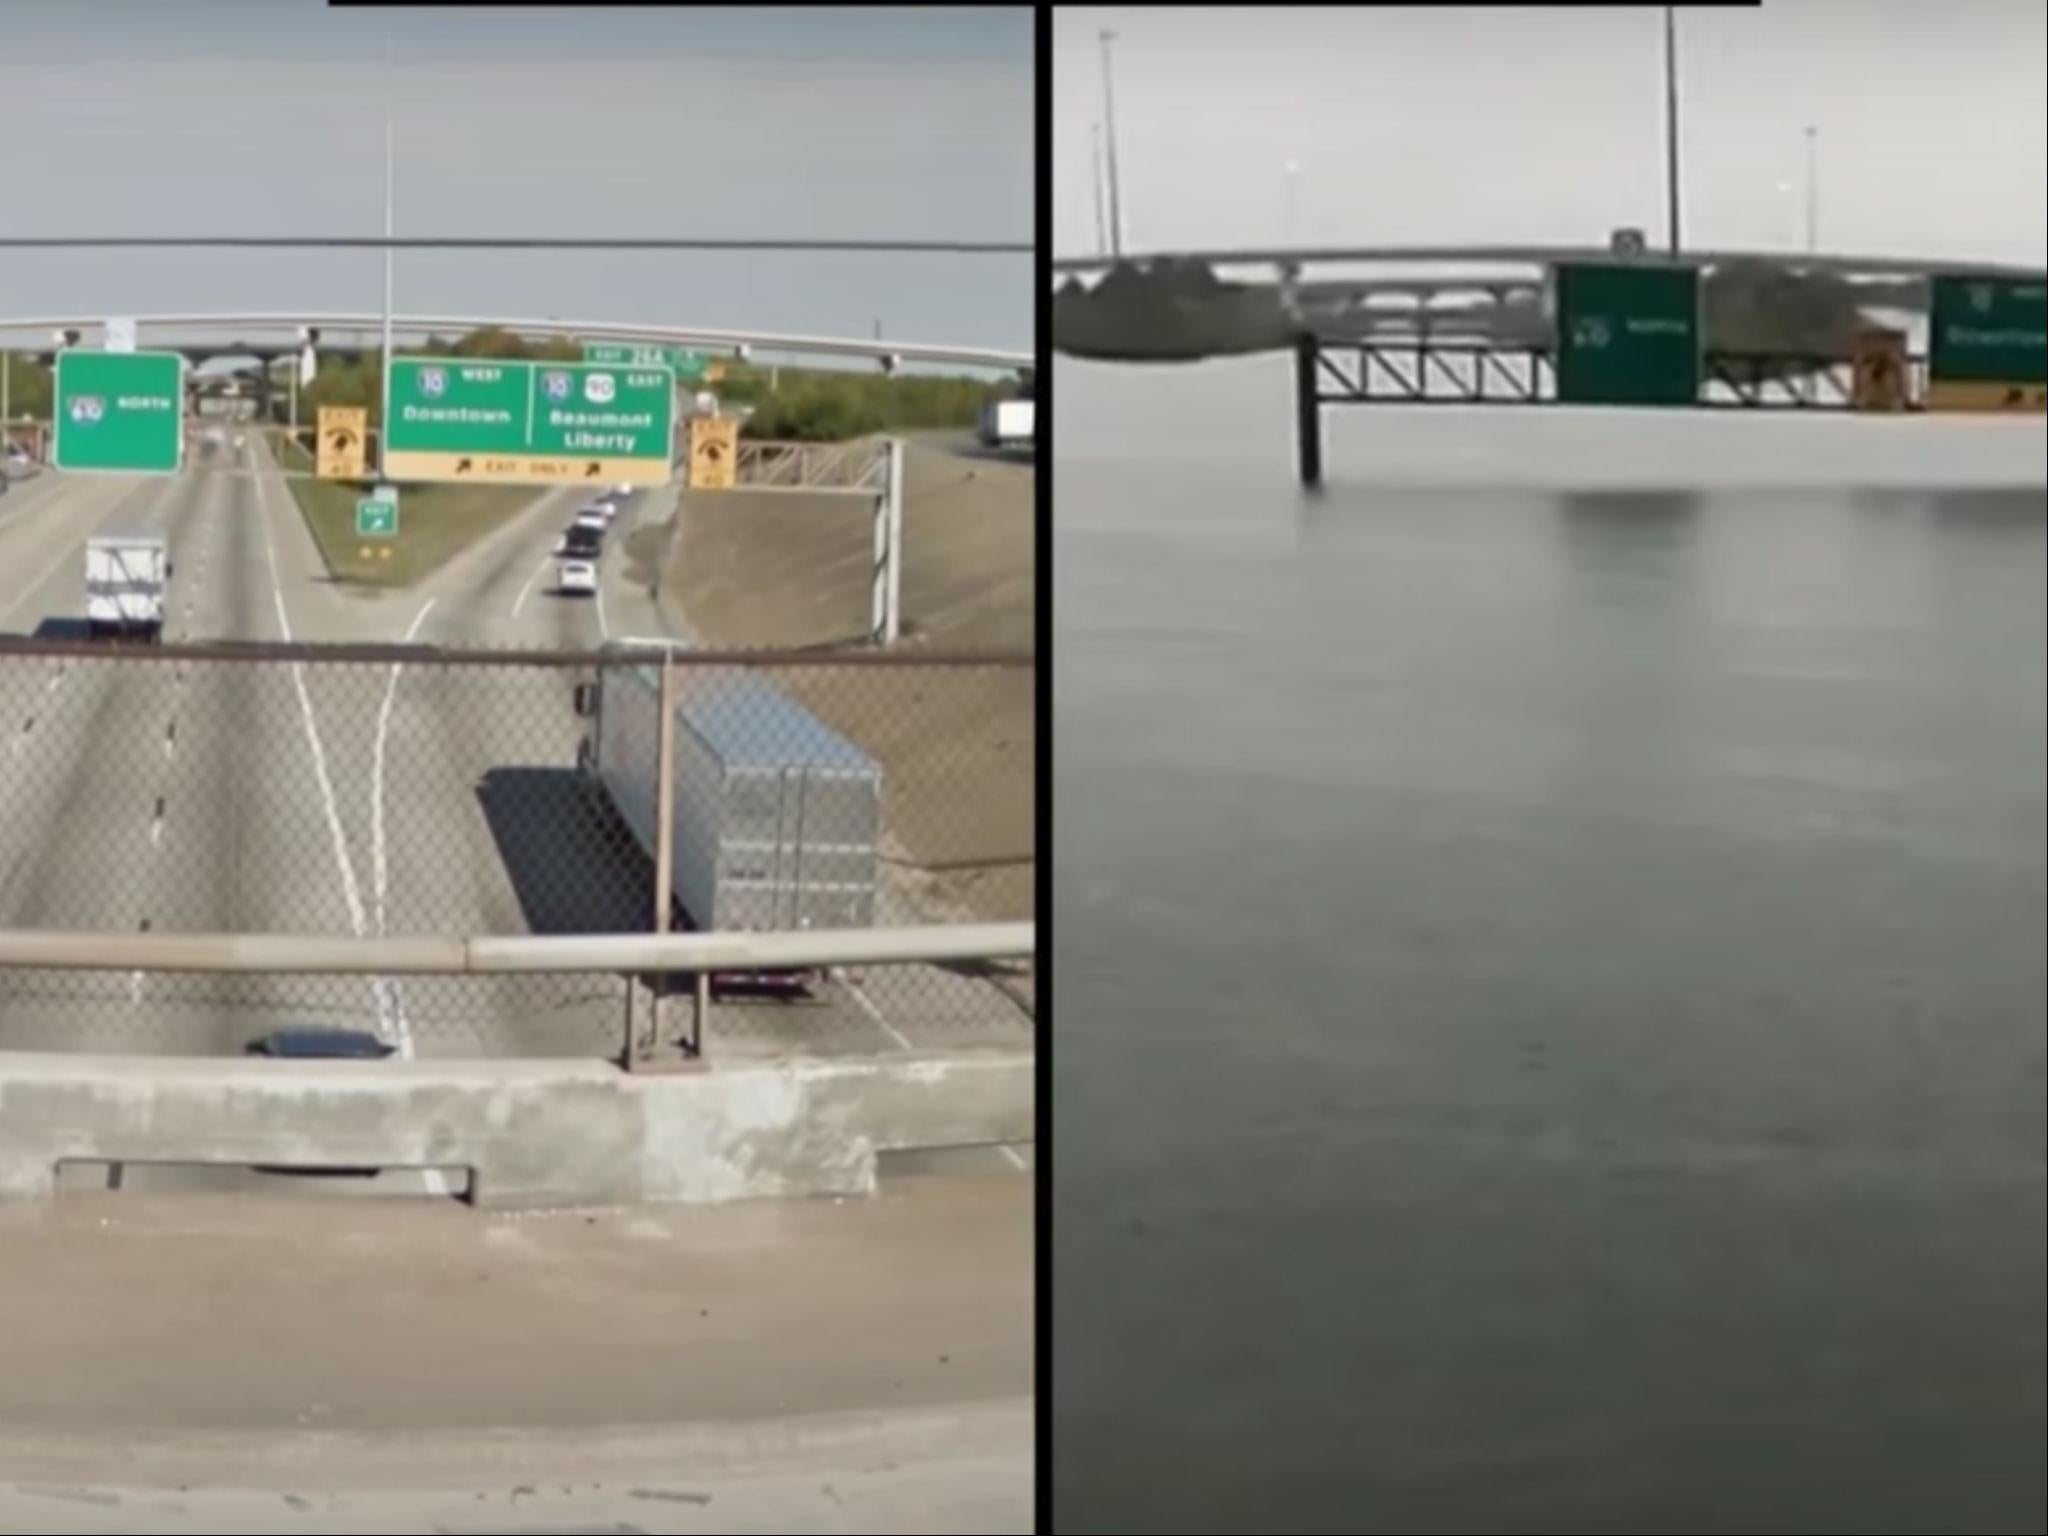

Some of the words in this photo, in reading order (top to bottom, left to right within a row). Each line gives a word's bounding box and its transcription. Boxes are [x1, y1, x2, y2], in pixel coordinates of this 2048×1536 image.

[460, 366, 504, 380] WEST
[626, 374, 663, 387] EAST
[116, 396, 171, 409] NORTH
[402, 405, 511, 424] Downtown
[549, 410, 652, 428] Beaumont
[564, 433, 636, 452] Liberty
